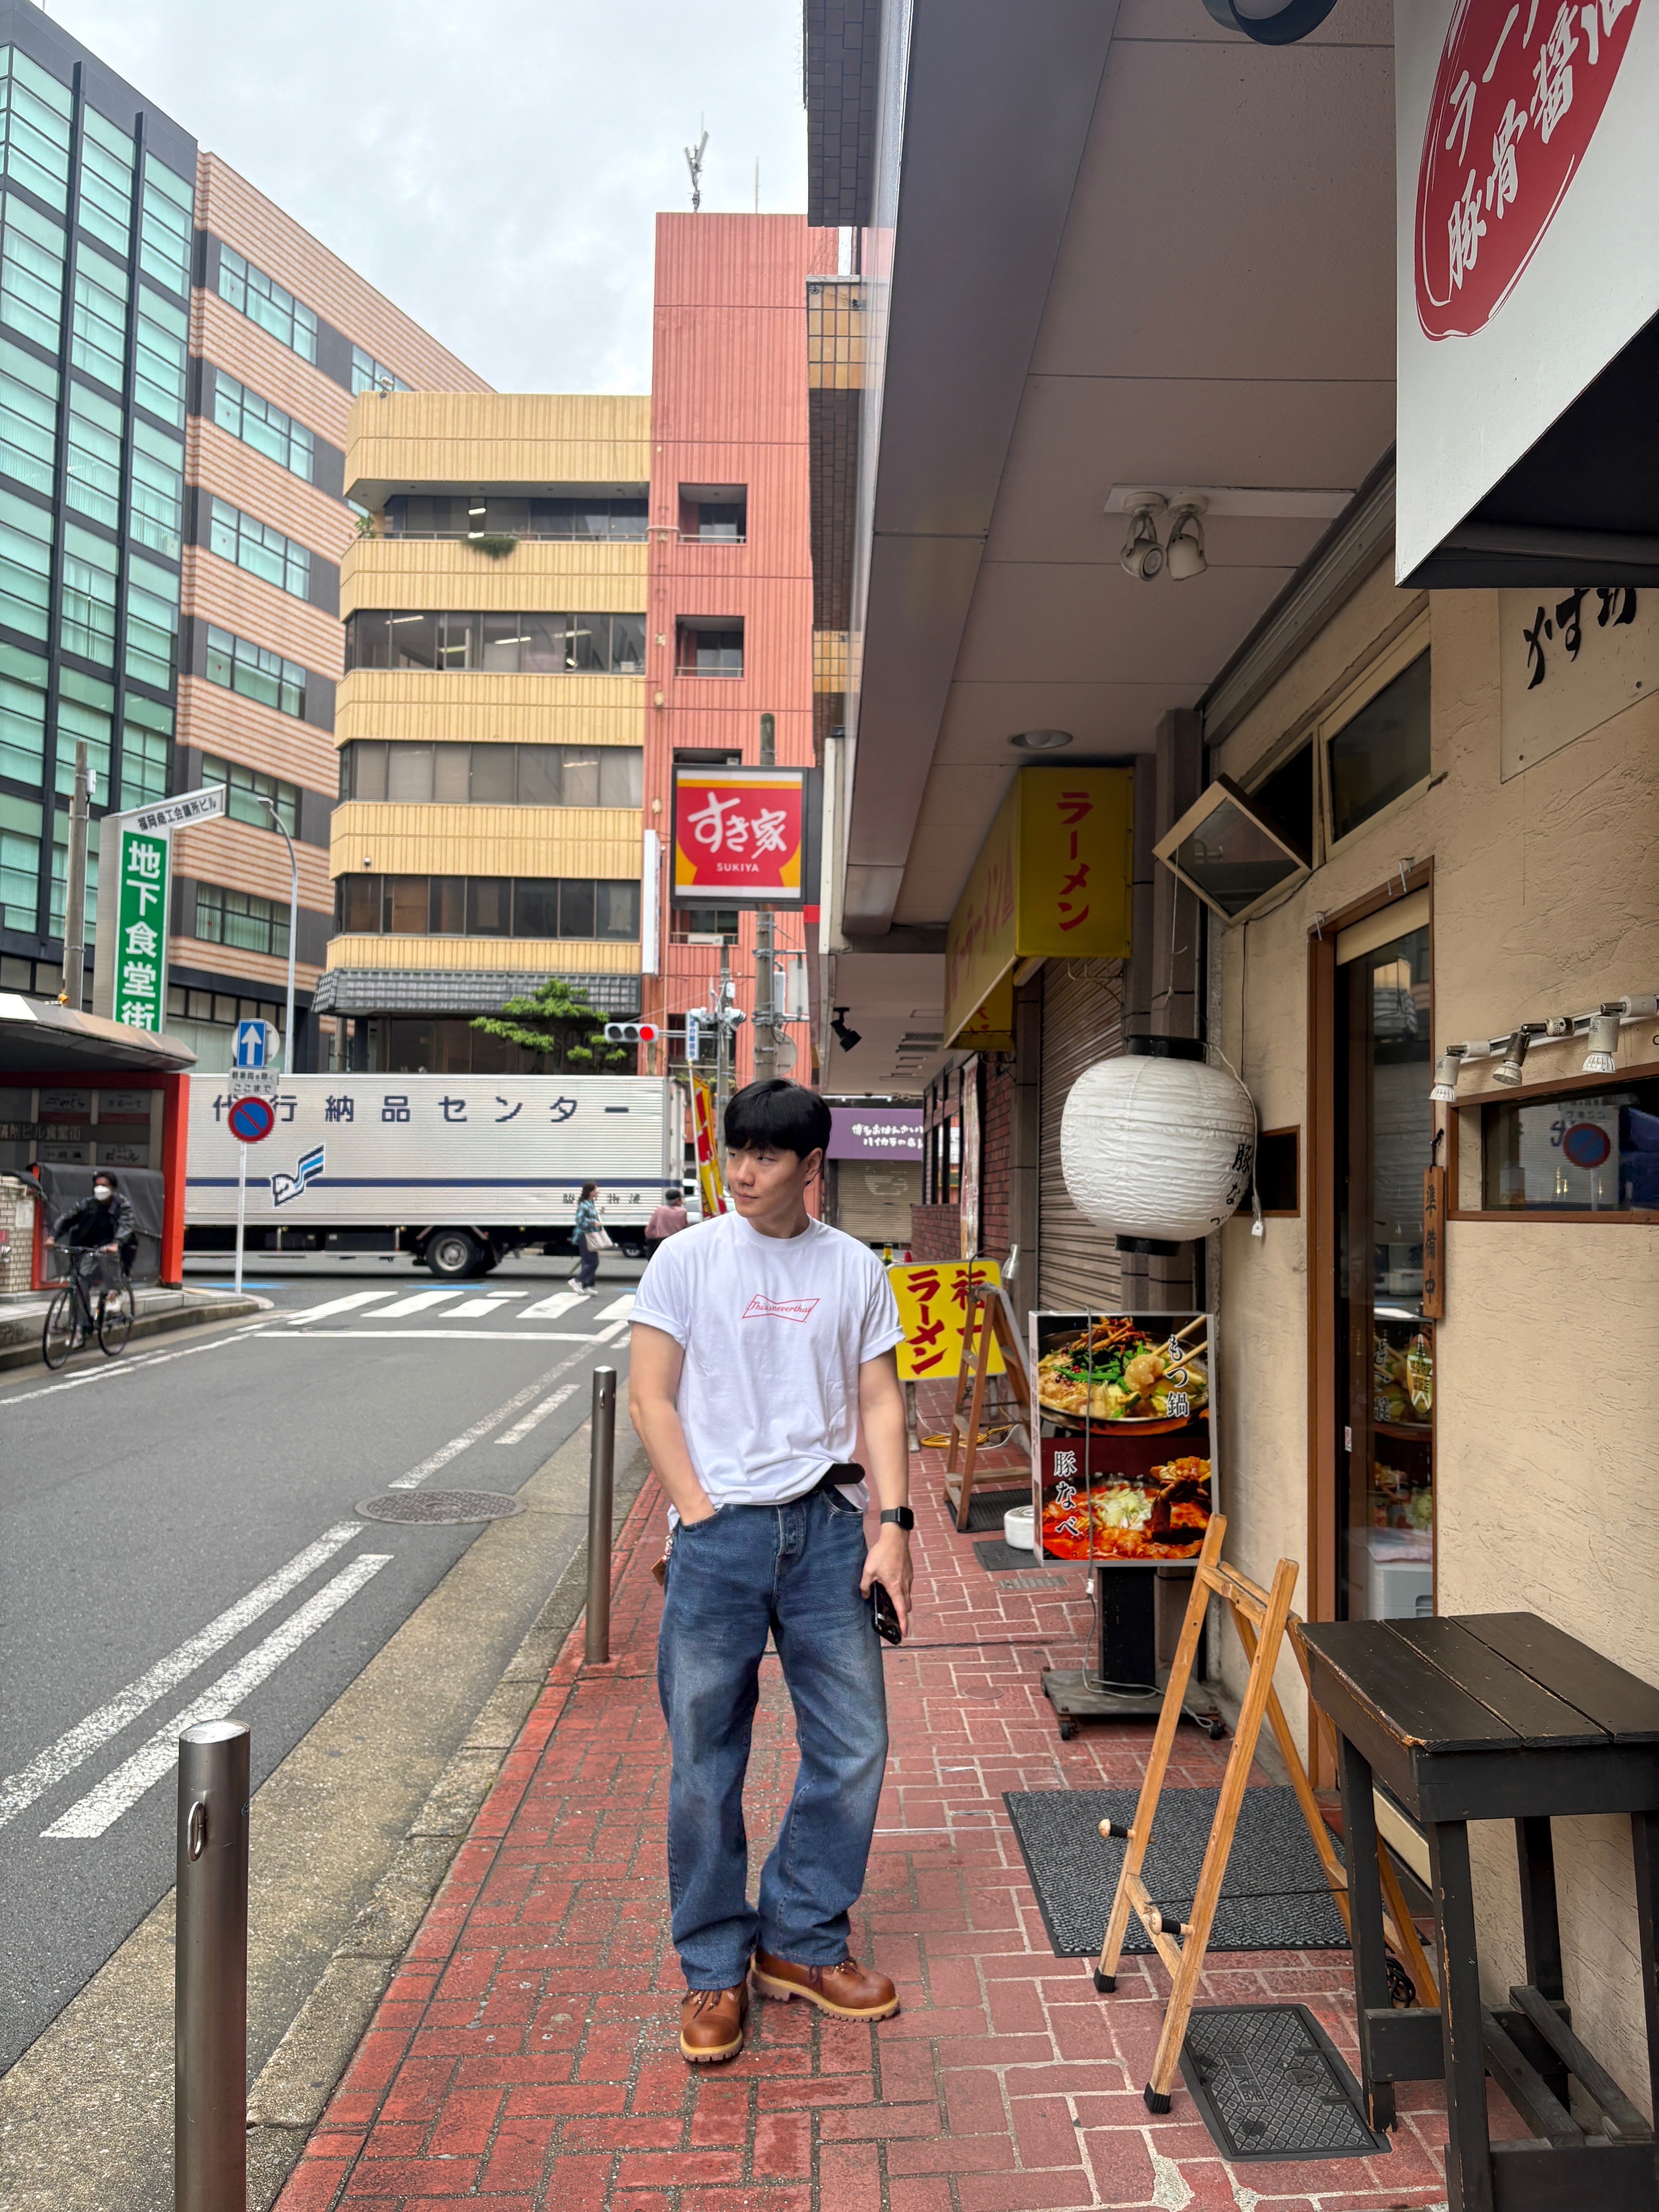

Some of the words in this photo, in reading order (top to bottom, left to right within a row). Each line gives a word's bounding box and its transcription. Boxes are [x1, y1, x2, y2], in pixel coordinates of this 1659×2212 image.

[1445, 0, 1539, 166] ラー
[138, 796, 217, 831] 福岡商工会議所ビル
[687, 791, 787, 859] すき家
[716, 862, 759, 873] SUKIYA
[1056, 791, 1094, 933] ラーメン
[121, 840, 162, 1032] 地下食堂街
[233, 1083, 272, 1094] ここまで
[1425, 1184, 1437, 1305] 準備中
[906, 1268, 948, 1375] ラーメン
[1165, 1333, 1190, 1418] もつ鍋
[1053, 1450, 1080, 1536] 豚なべ
